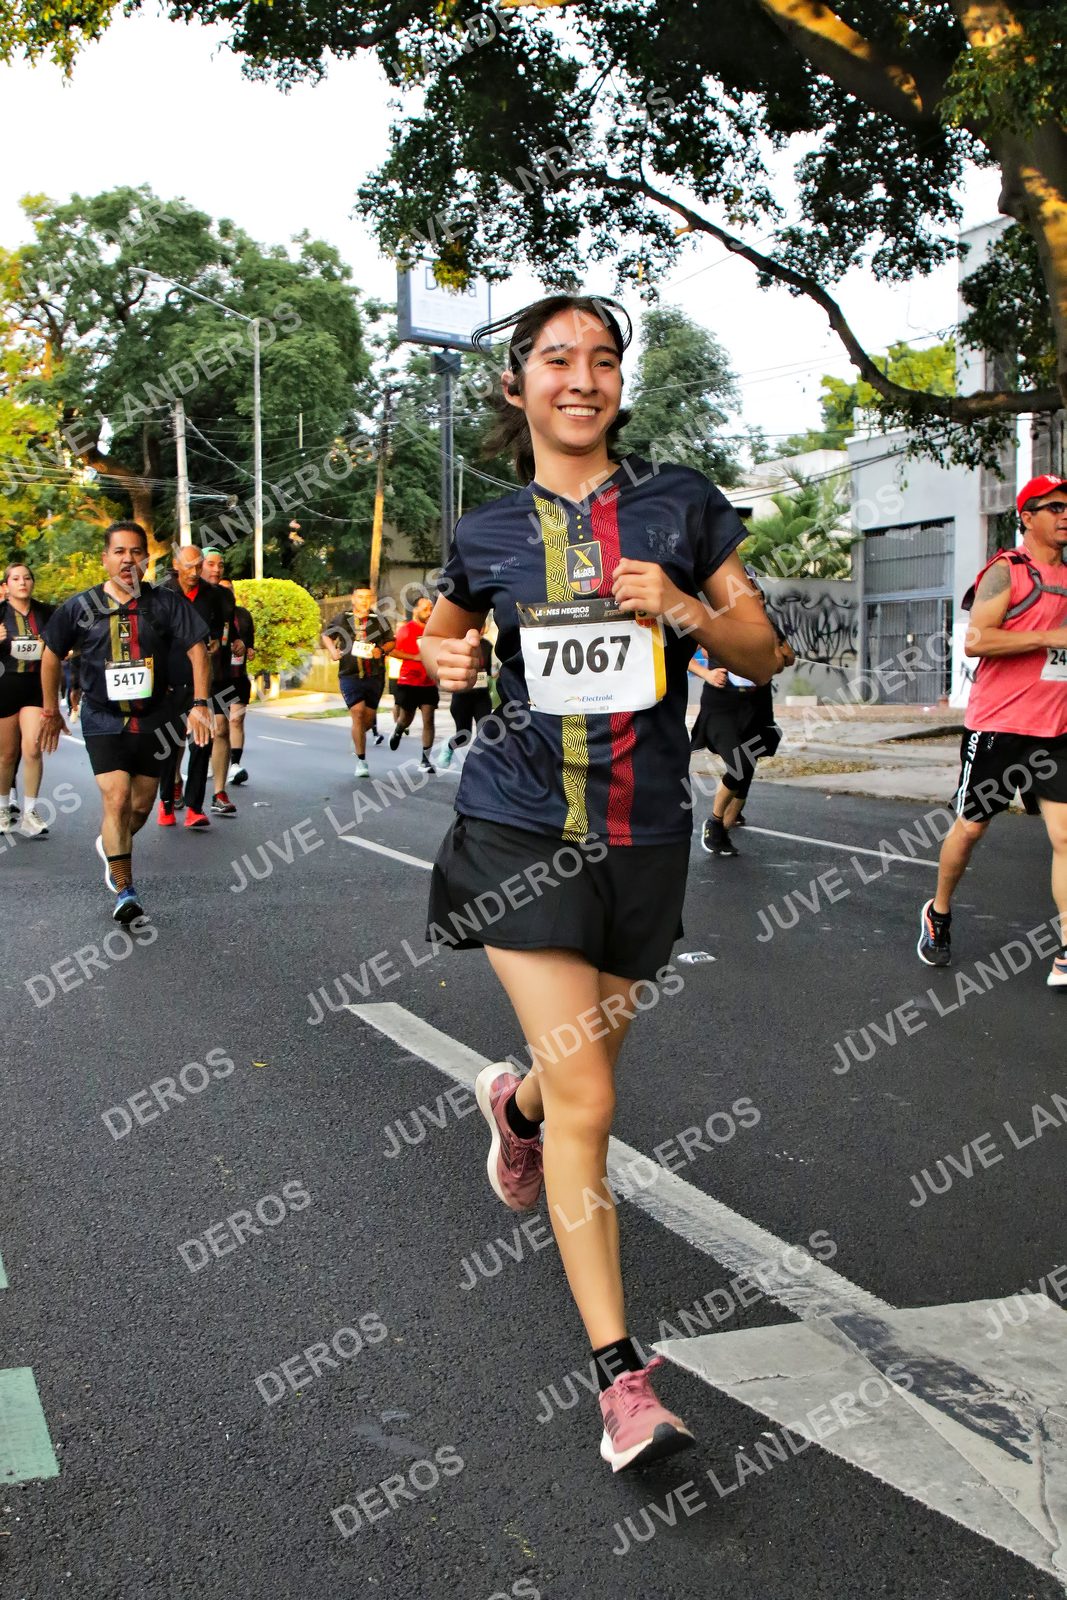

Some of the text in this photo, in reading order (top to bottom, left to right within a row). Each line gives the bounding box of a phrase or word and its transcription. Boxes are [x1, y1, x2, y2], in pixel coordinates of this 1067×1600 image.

[16, 644, 37, 652] 1587
[537, 635, 631, 677] 7067
[114, 672, 144, 687] 5417
